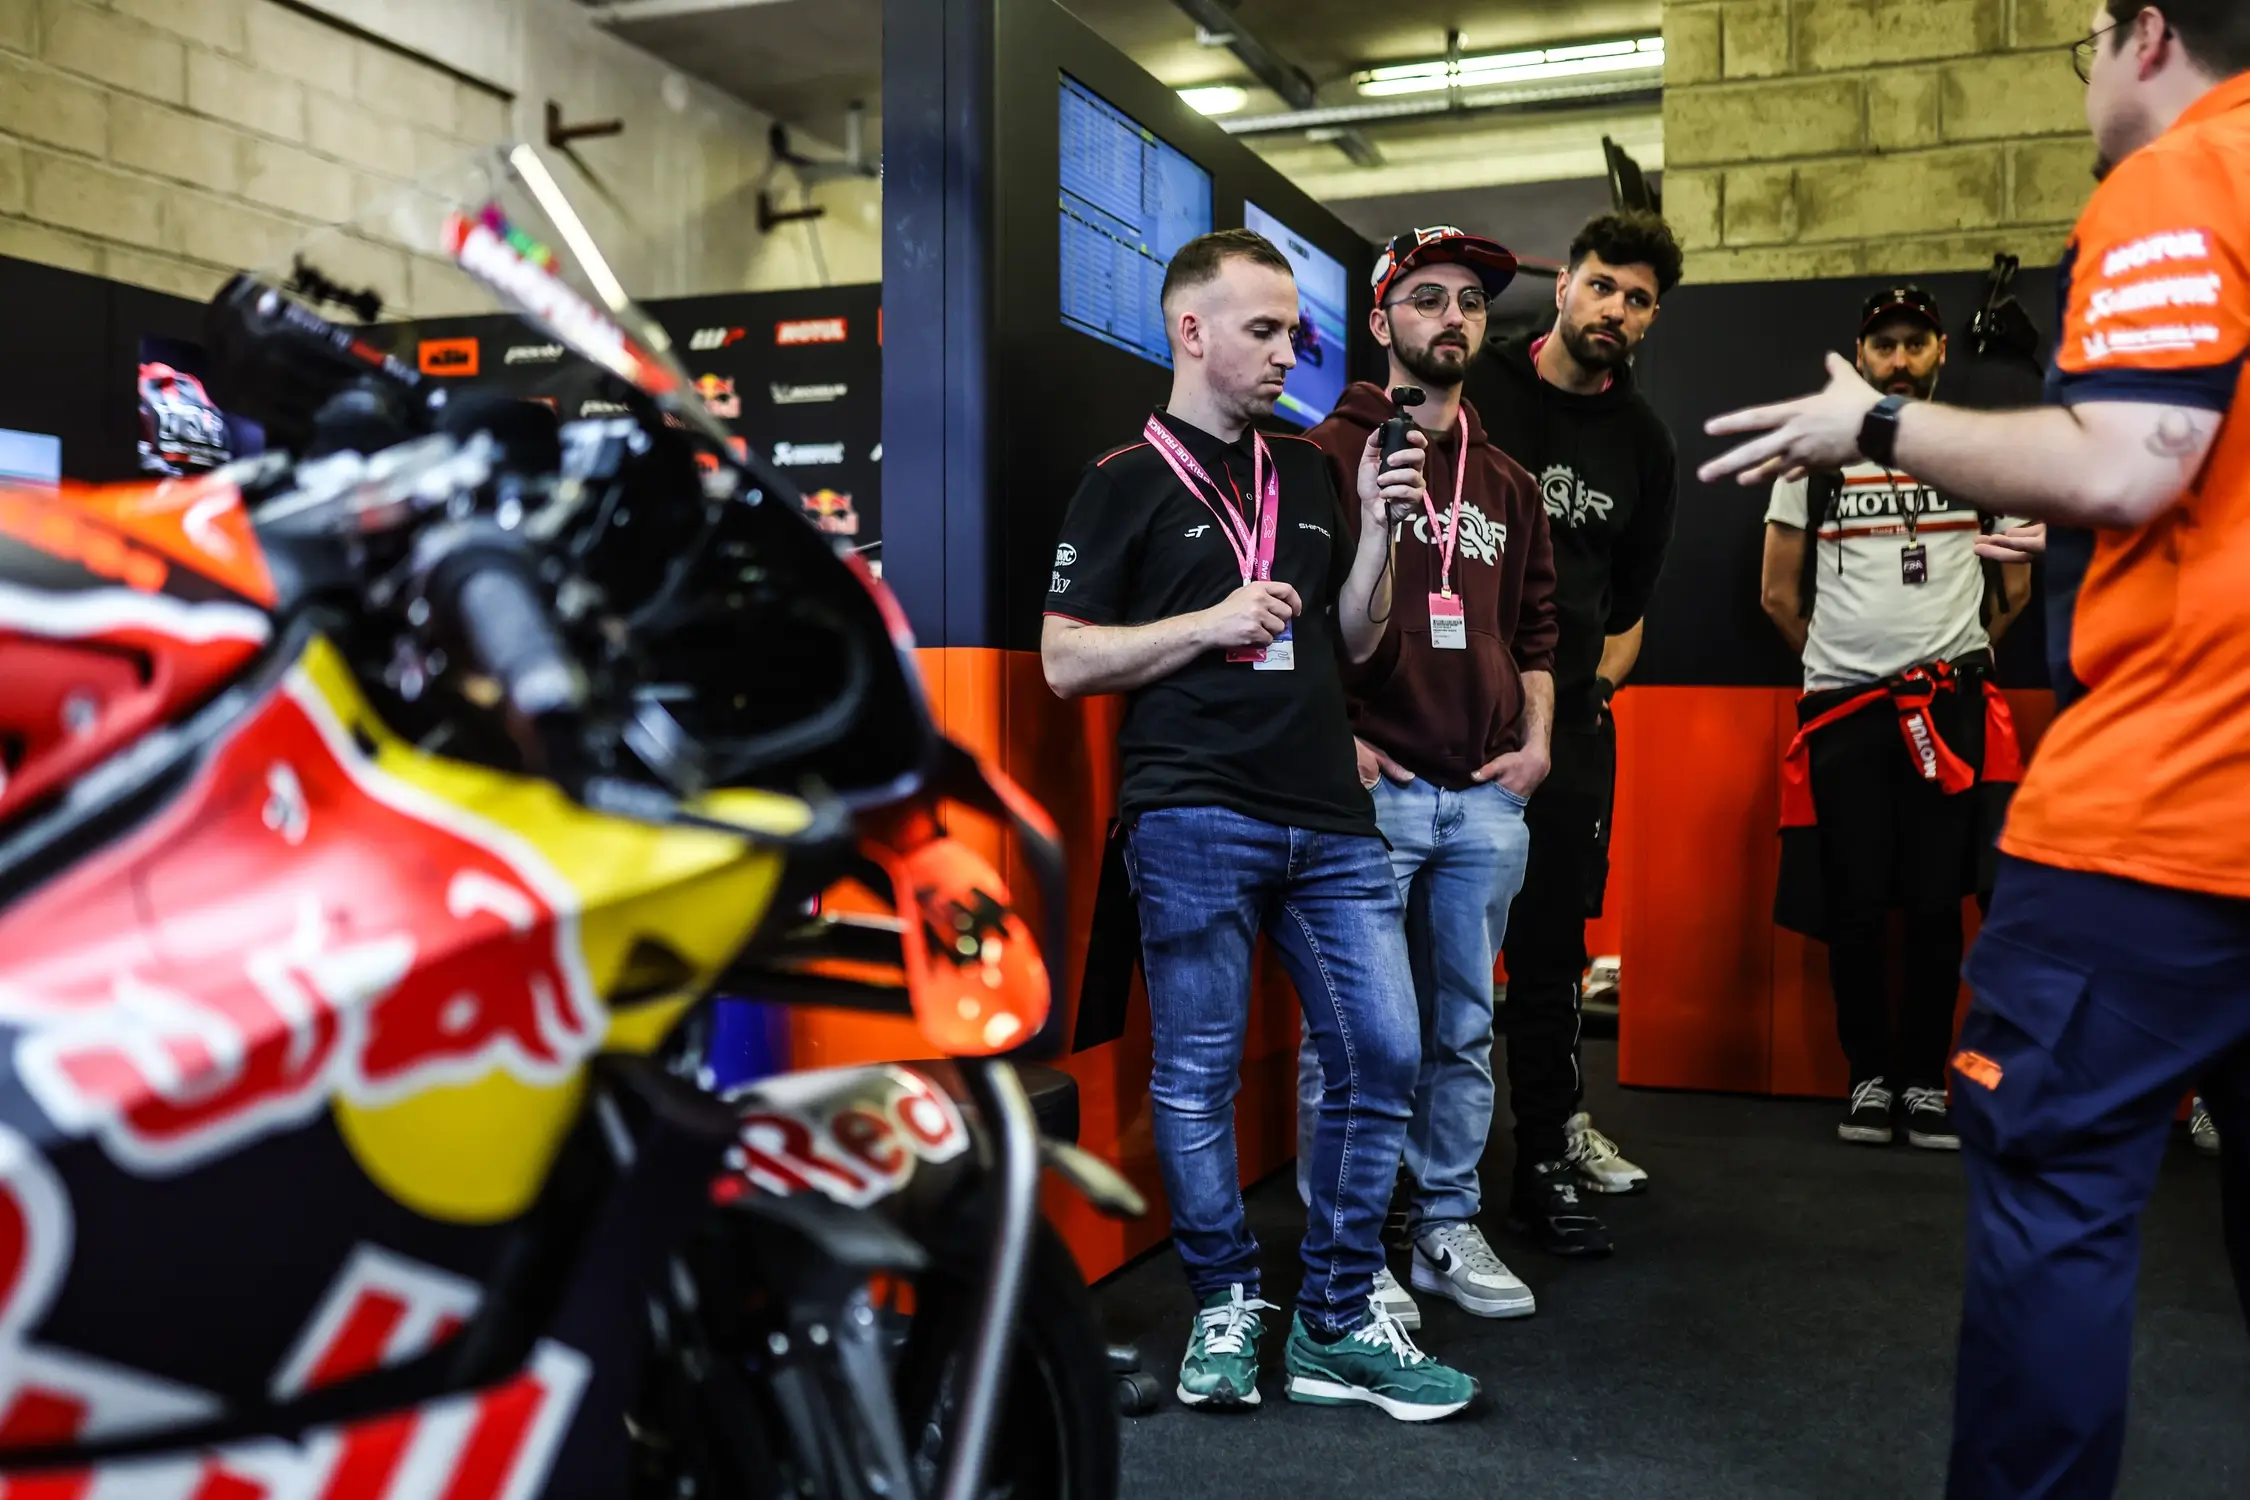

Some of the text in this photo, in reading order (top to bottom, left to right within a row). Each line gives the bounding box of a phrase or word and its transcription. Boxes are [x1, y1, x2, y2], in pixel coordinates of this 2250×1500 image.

[1147, 418, 1179, 450] FRANCE
[1175, 446, 1189, 461] DE
[1837, 490, 1949, 518] MOTUL
[1907, 713, 1937, 778] MOTUL
